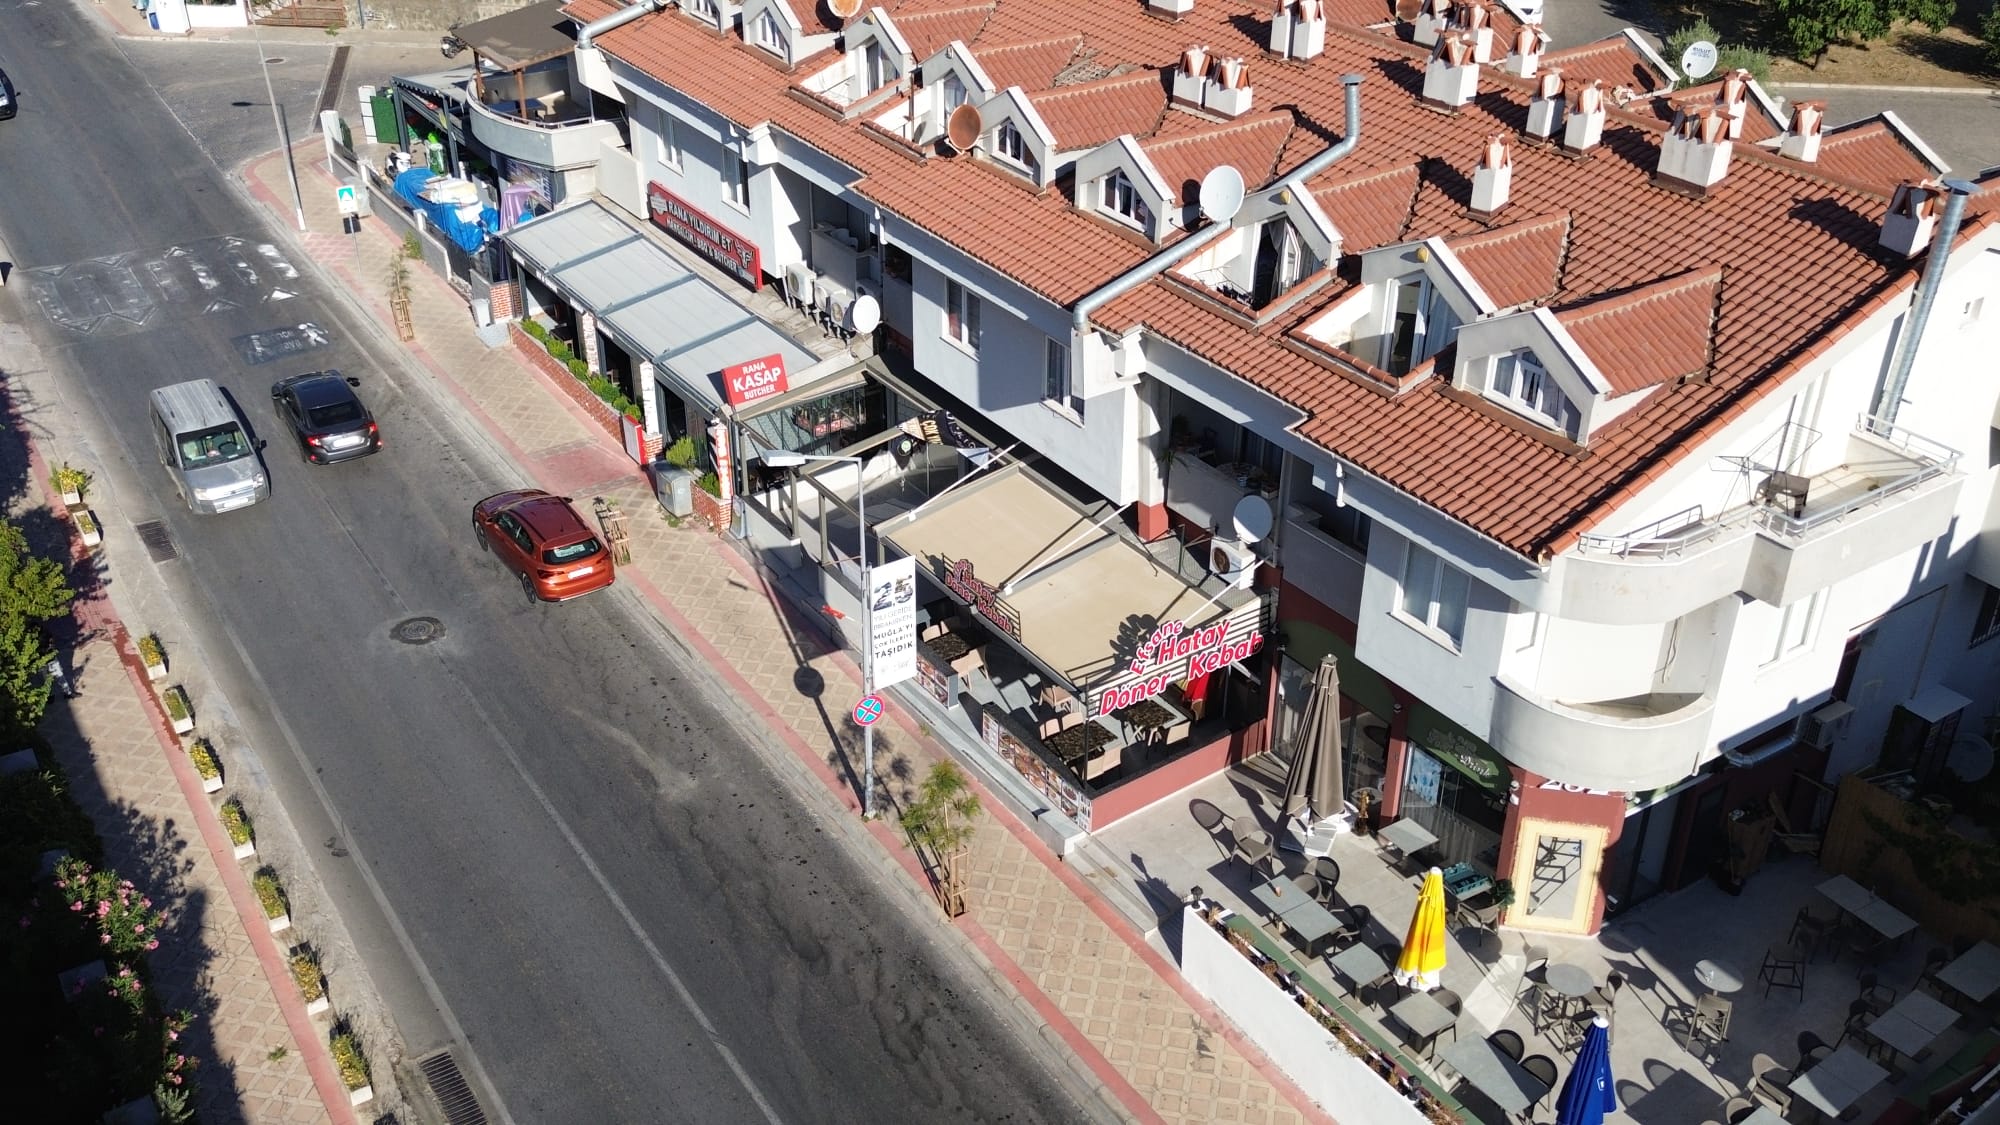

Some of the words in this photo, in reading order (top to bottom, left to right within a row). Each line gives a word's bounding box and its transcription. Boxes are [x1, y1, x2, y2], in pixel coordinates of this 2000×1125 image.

[668, 200, 688, 224] RANA
[689, 213, 720, 244] YILDIRIM
[721, 238, 732, 253] ET
[714, 247, 737, 272] BUTCHER
[733, 367, 781, 393] KASAP
[742, 361, 767, 375] RANA
[744, 384, 776, 400] BUTCHER
[962, 569, 996, 606] Hatay
[977, 598, 1013, 634] Kebab
[875, 641, 913, 659] TAŞIDIK
[1130, 619, 1185, 676] Efsane
[1157, 619, 1231, 666] Hatay
[1100, 672, 1172, 717] Döner
[1188, 630, 1265, 681] Kebab
[1460, 754, 1490, 777] Drink
